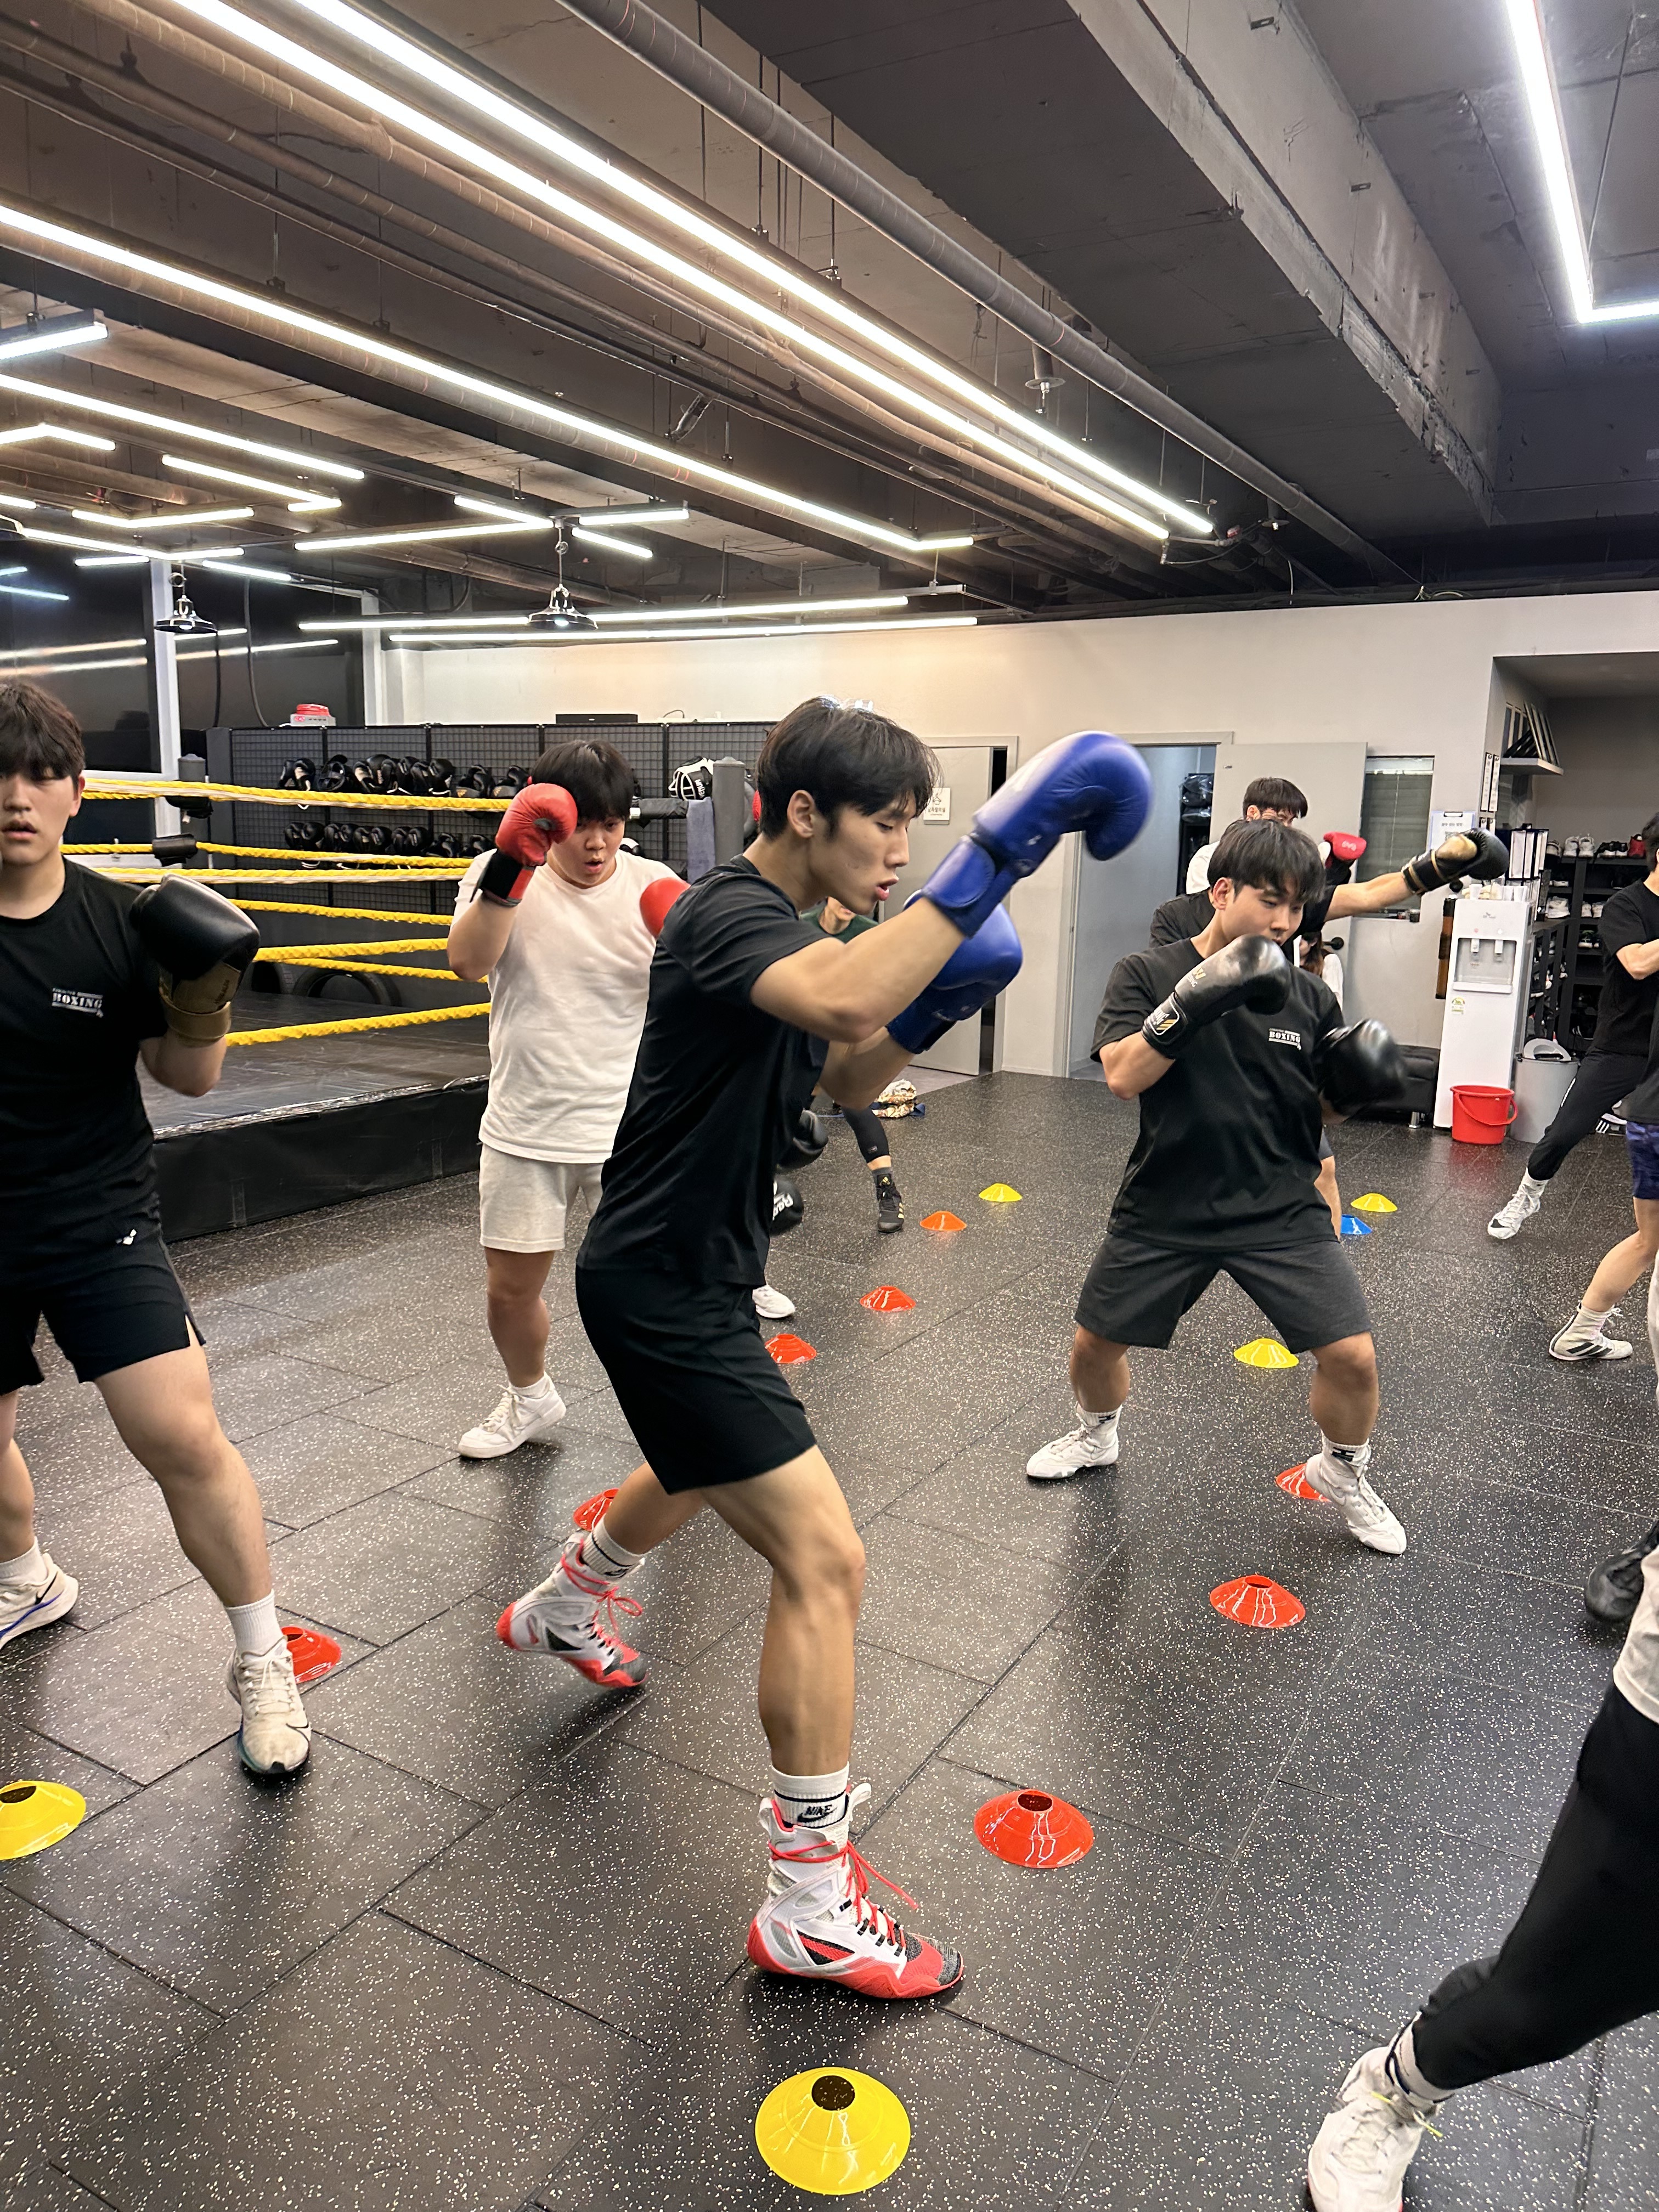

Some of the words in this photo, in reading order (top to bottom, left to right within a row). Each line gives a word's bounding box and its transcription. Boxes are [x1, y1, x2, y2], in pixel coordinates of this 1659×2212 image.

[53, 992, 103, 1008] BOXING
[1269, 1031, 1301, 1043] BOXING
[804, 1804, 832, 1816] NIKE
